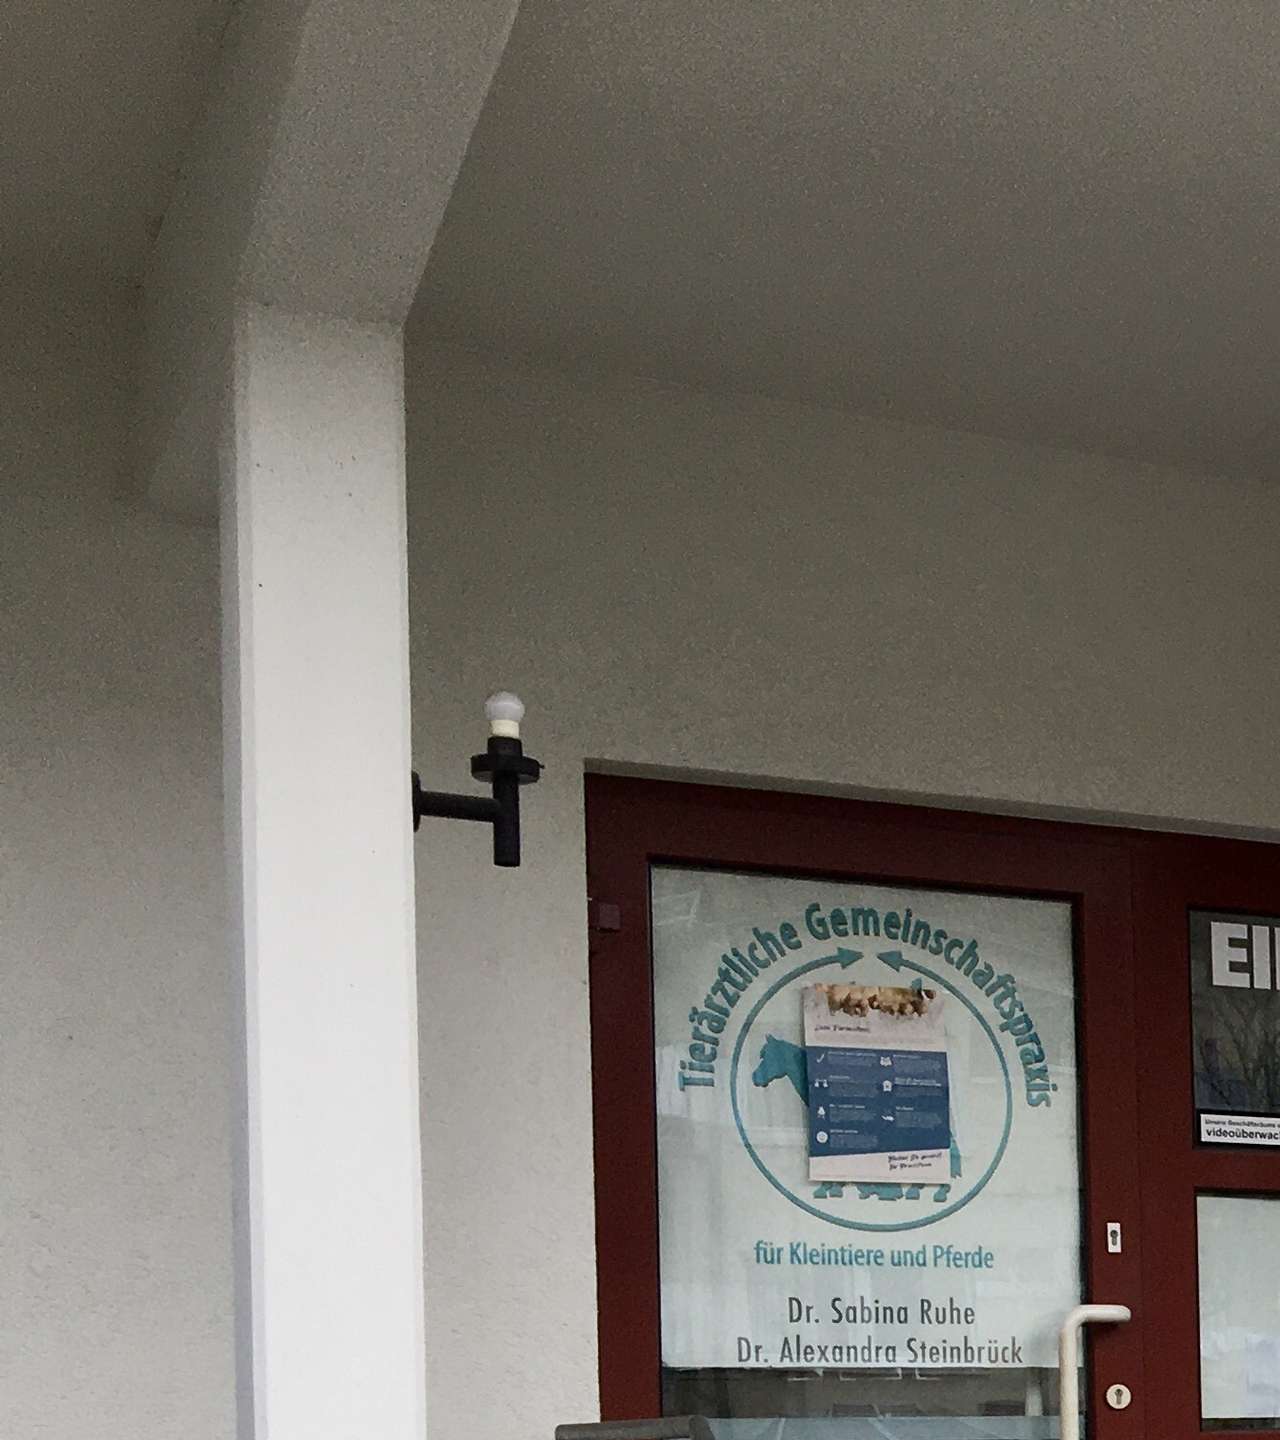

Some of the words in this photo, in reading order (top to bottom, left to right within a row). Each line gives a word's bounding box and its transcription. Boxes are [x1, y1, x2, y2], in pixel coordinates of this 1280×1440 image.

[678, 922, 803, 1091] Tierärztliche
[805, 902, 1058, 1107] Gemeinschaftspraxis
[753, 1240, 783, 1266] für
[789, 1242, 885, 1267] Kleintiere
[890, 1245, 927, 1268] und
[933, 1245, 994, 1269] Pferde
[788, 1297, 820, 1324] Dr.
[831, 1296, 909, 1325] Sabina
[920, 1297, 976, 1325] Ruhe
[737, 1336, 769, 1363] Dr.
[779, 1334, 897, 1364] Alexandra
[906, 1335, 1024, 1364] Steinbrück
